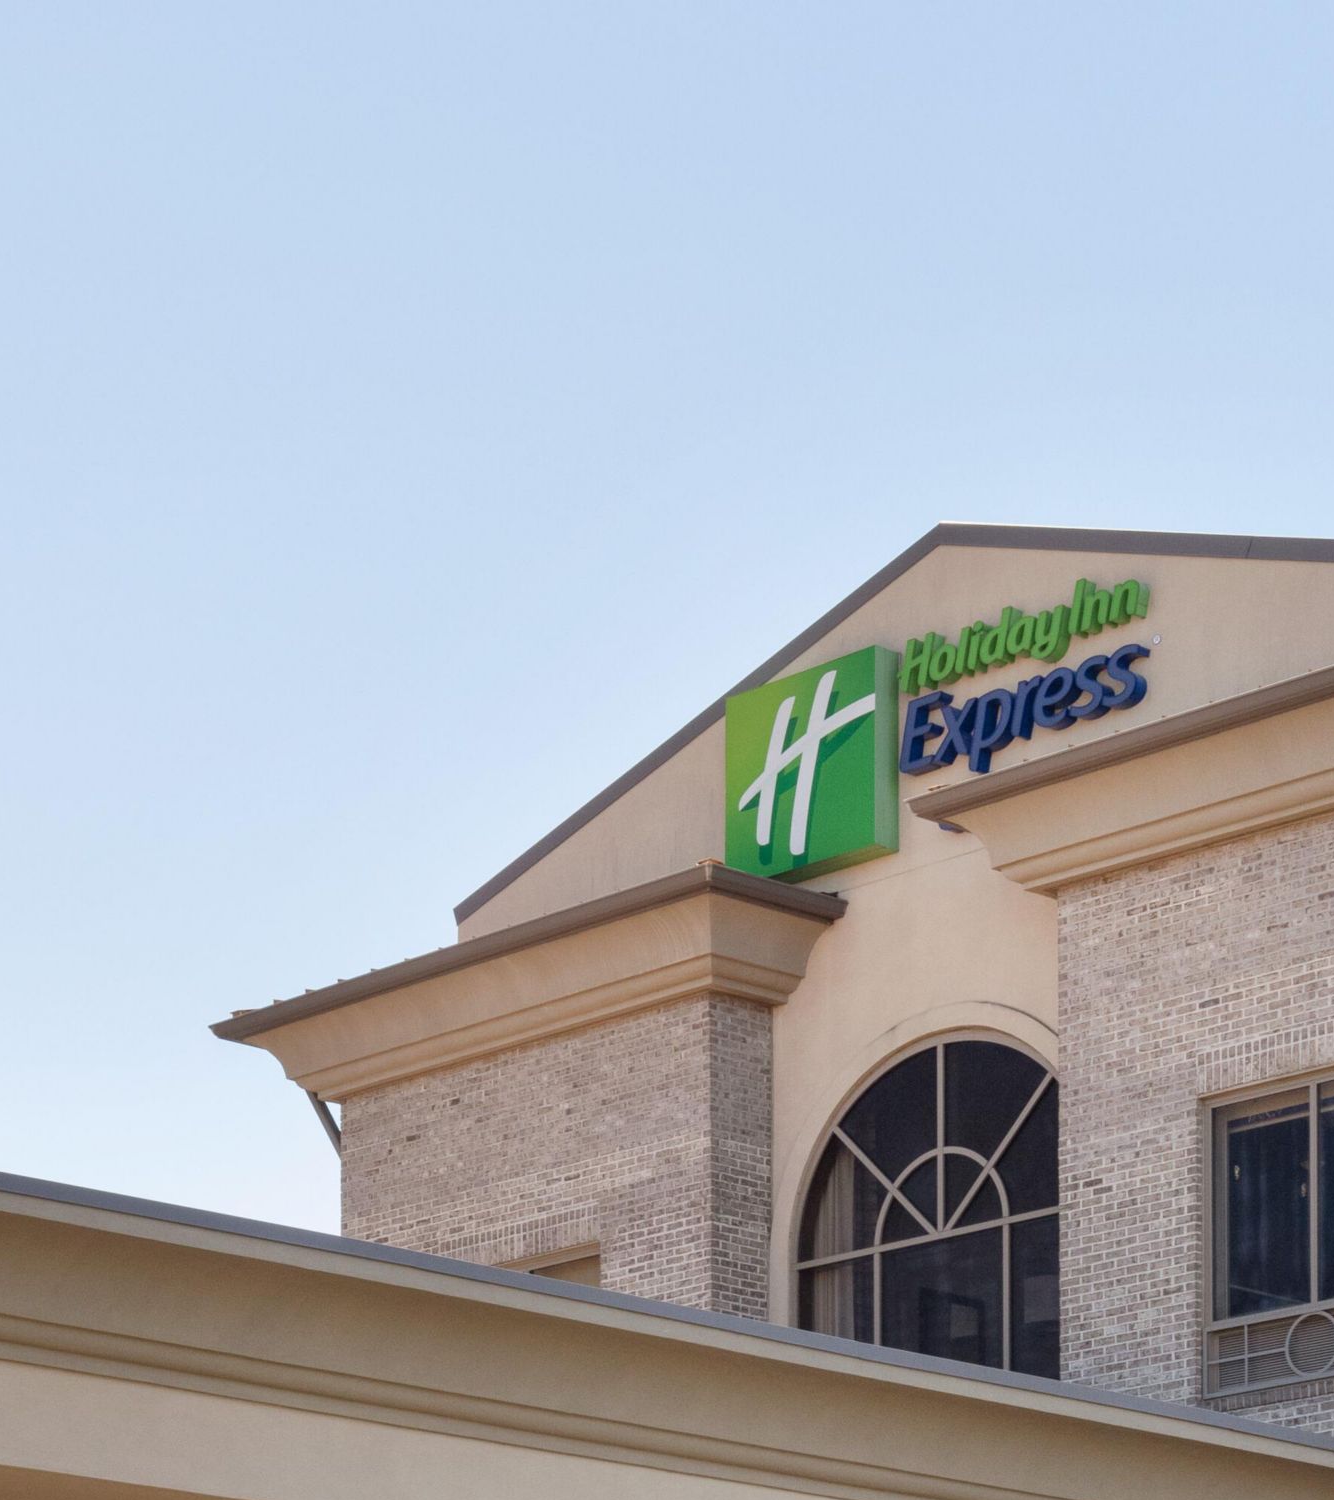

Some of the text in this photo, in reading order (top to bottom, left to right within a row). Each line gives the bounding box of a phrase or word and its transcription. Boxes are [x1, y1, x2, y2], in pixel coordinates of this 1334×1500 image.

[899, 578, 1150, 696] Holiday Inn
[738, 669, 876, 856] H
[899, 643, 1151, 775] Express
